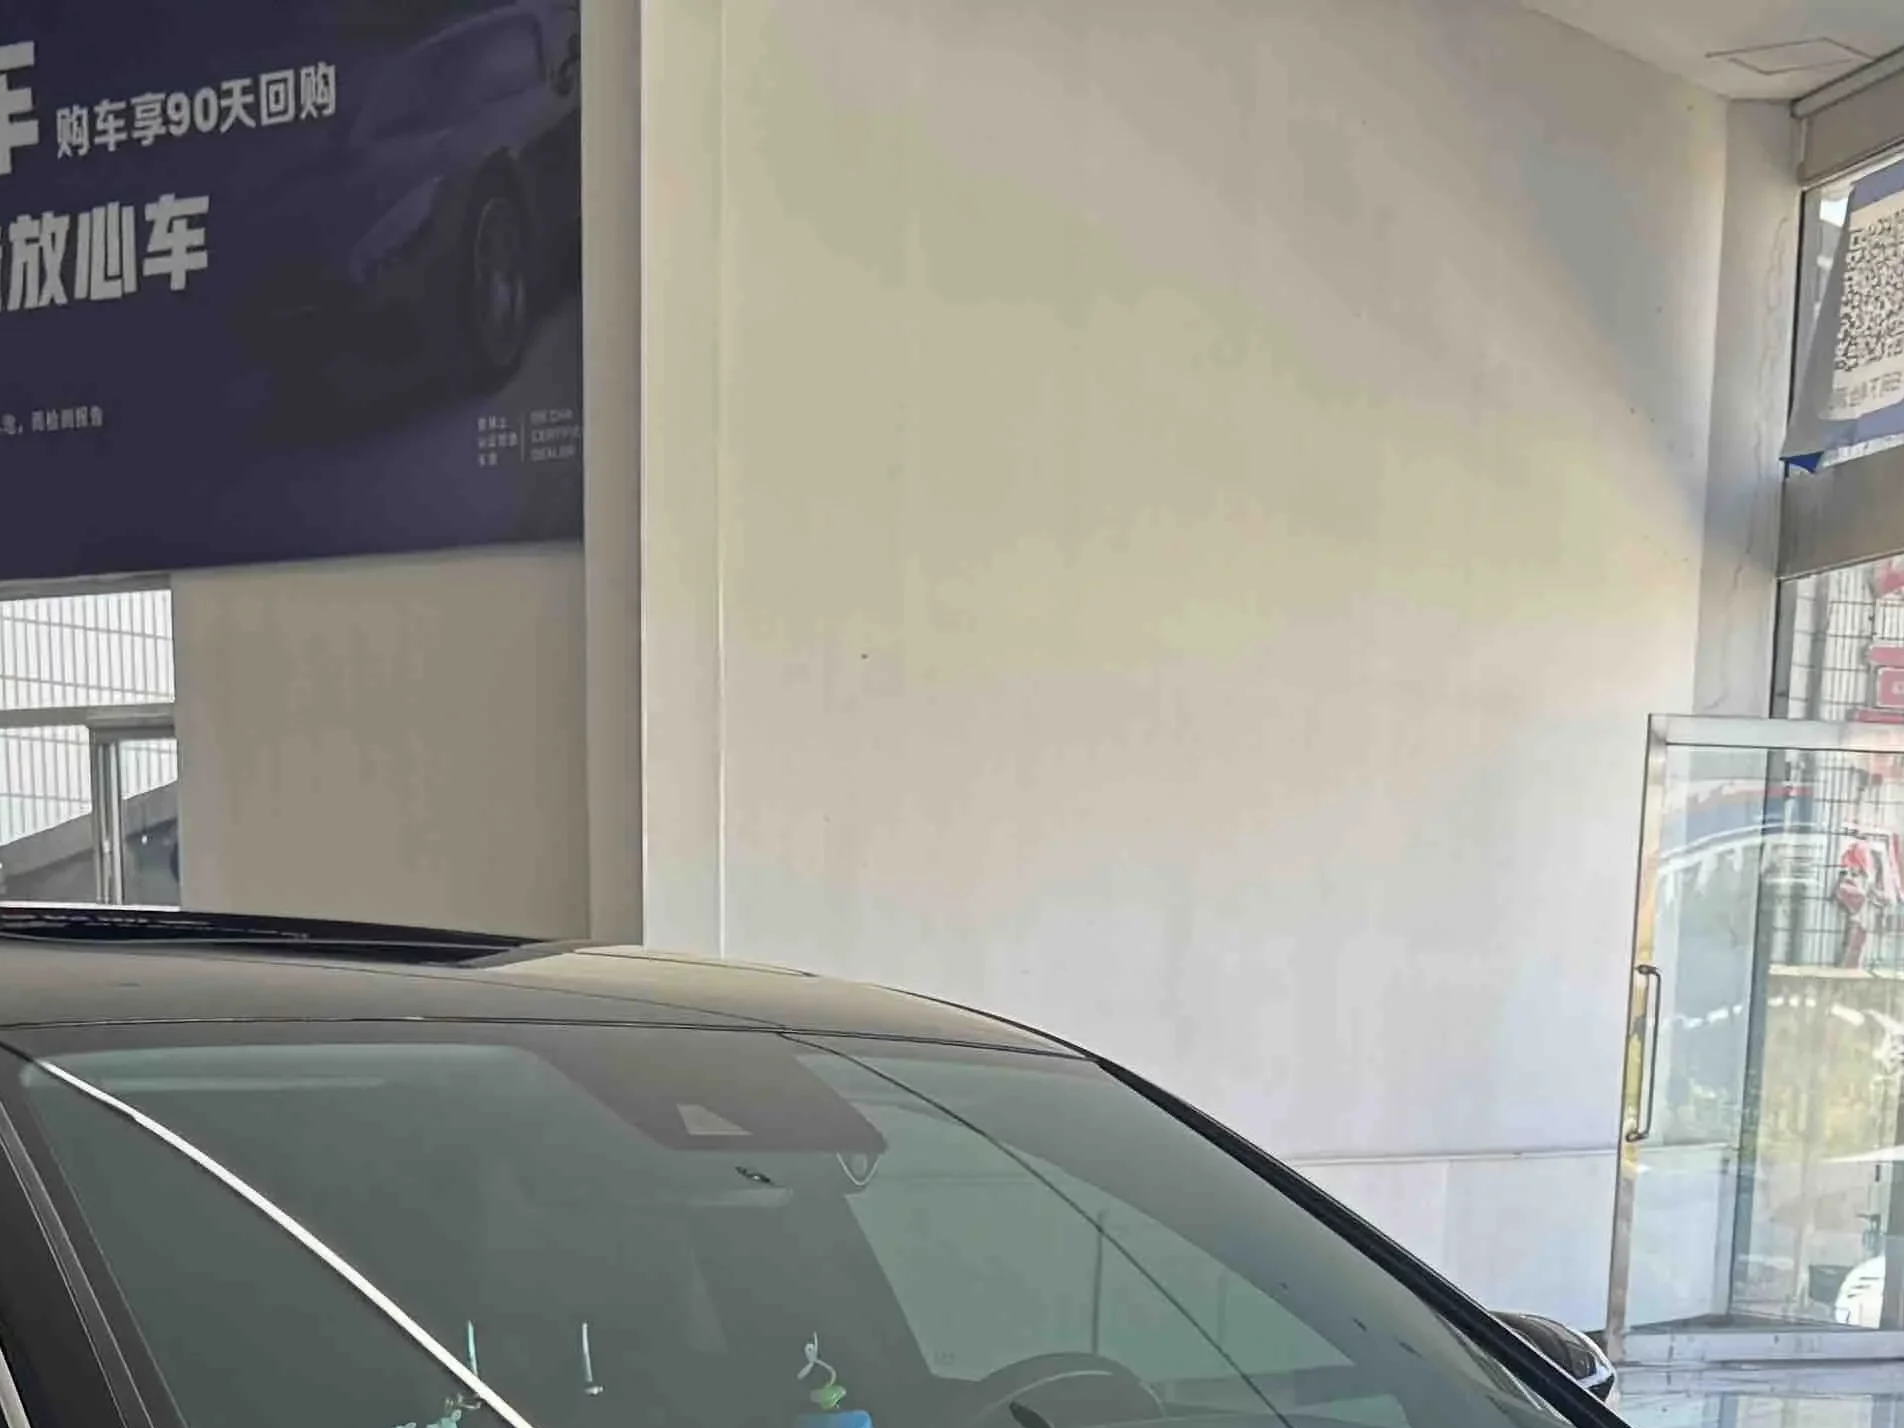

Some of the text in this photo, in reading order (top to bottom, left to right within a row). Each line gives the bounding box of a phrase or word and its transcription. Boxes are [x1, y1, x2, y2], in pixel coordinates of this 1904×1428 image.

[55, 61, 338, 160] 购车享90天回购
